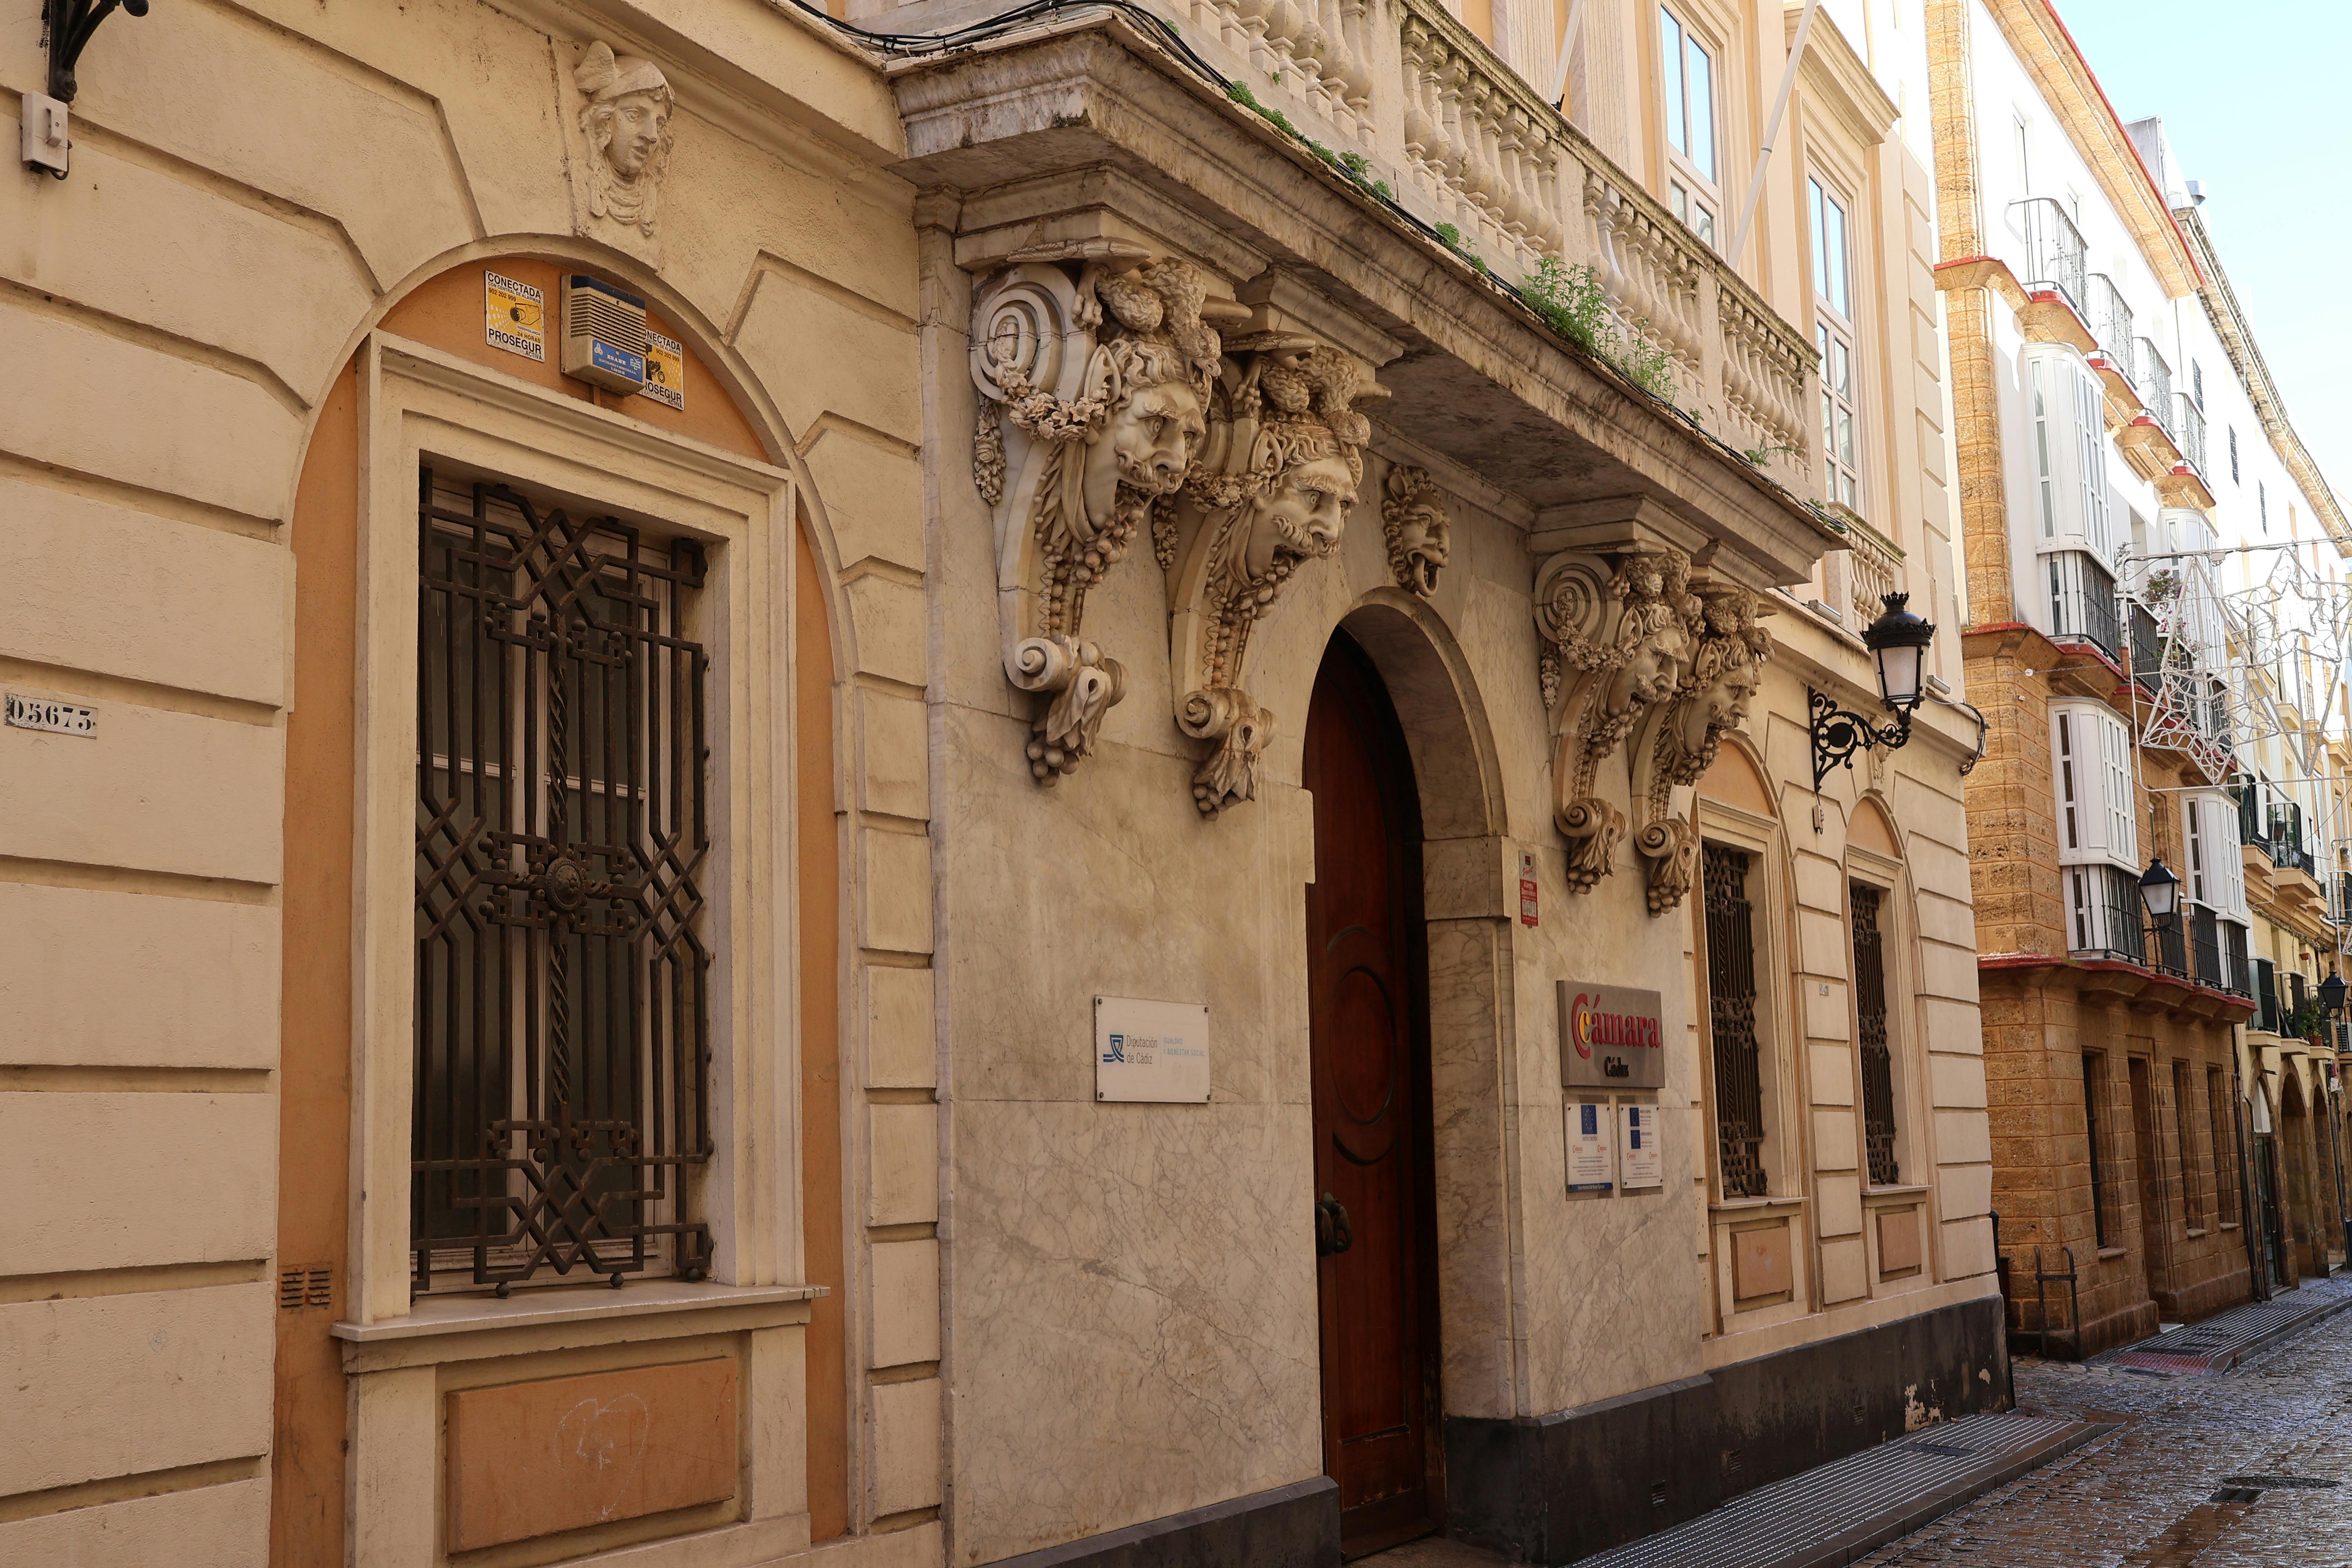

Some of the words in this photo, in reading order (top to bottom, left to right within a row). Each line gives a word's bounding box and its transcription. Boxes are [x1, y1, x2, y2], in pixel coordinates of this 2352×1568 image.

[488, 272, 541, 299] CONECTADA
[497, 285, 515, 294] CENTRAL
[522, 294, 541, 303] ALARMAS
[517, 325, 541, 336] VIDEOVIGILANCIA
[489, 328, 541, 355] PROSEGUR
[524, 334, 541, 343] HORAS
[525, 351, 542, 361] ACTIVA
[664, 345, 681, 356] ALARMAS
[607, 354, 626, 365] ESABE
[668, 399, 682, 408] ACTIVA
[9, 700, 91, 730] 05673
[1127, 1035, 1157, 1049] Diputación
[1127, 1052, 1134, 1063] de
[1136, 1052, 1152, 1064] Cádiz
[1604, 1056, 1629, 1077] Cádiz
